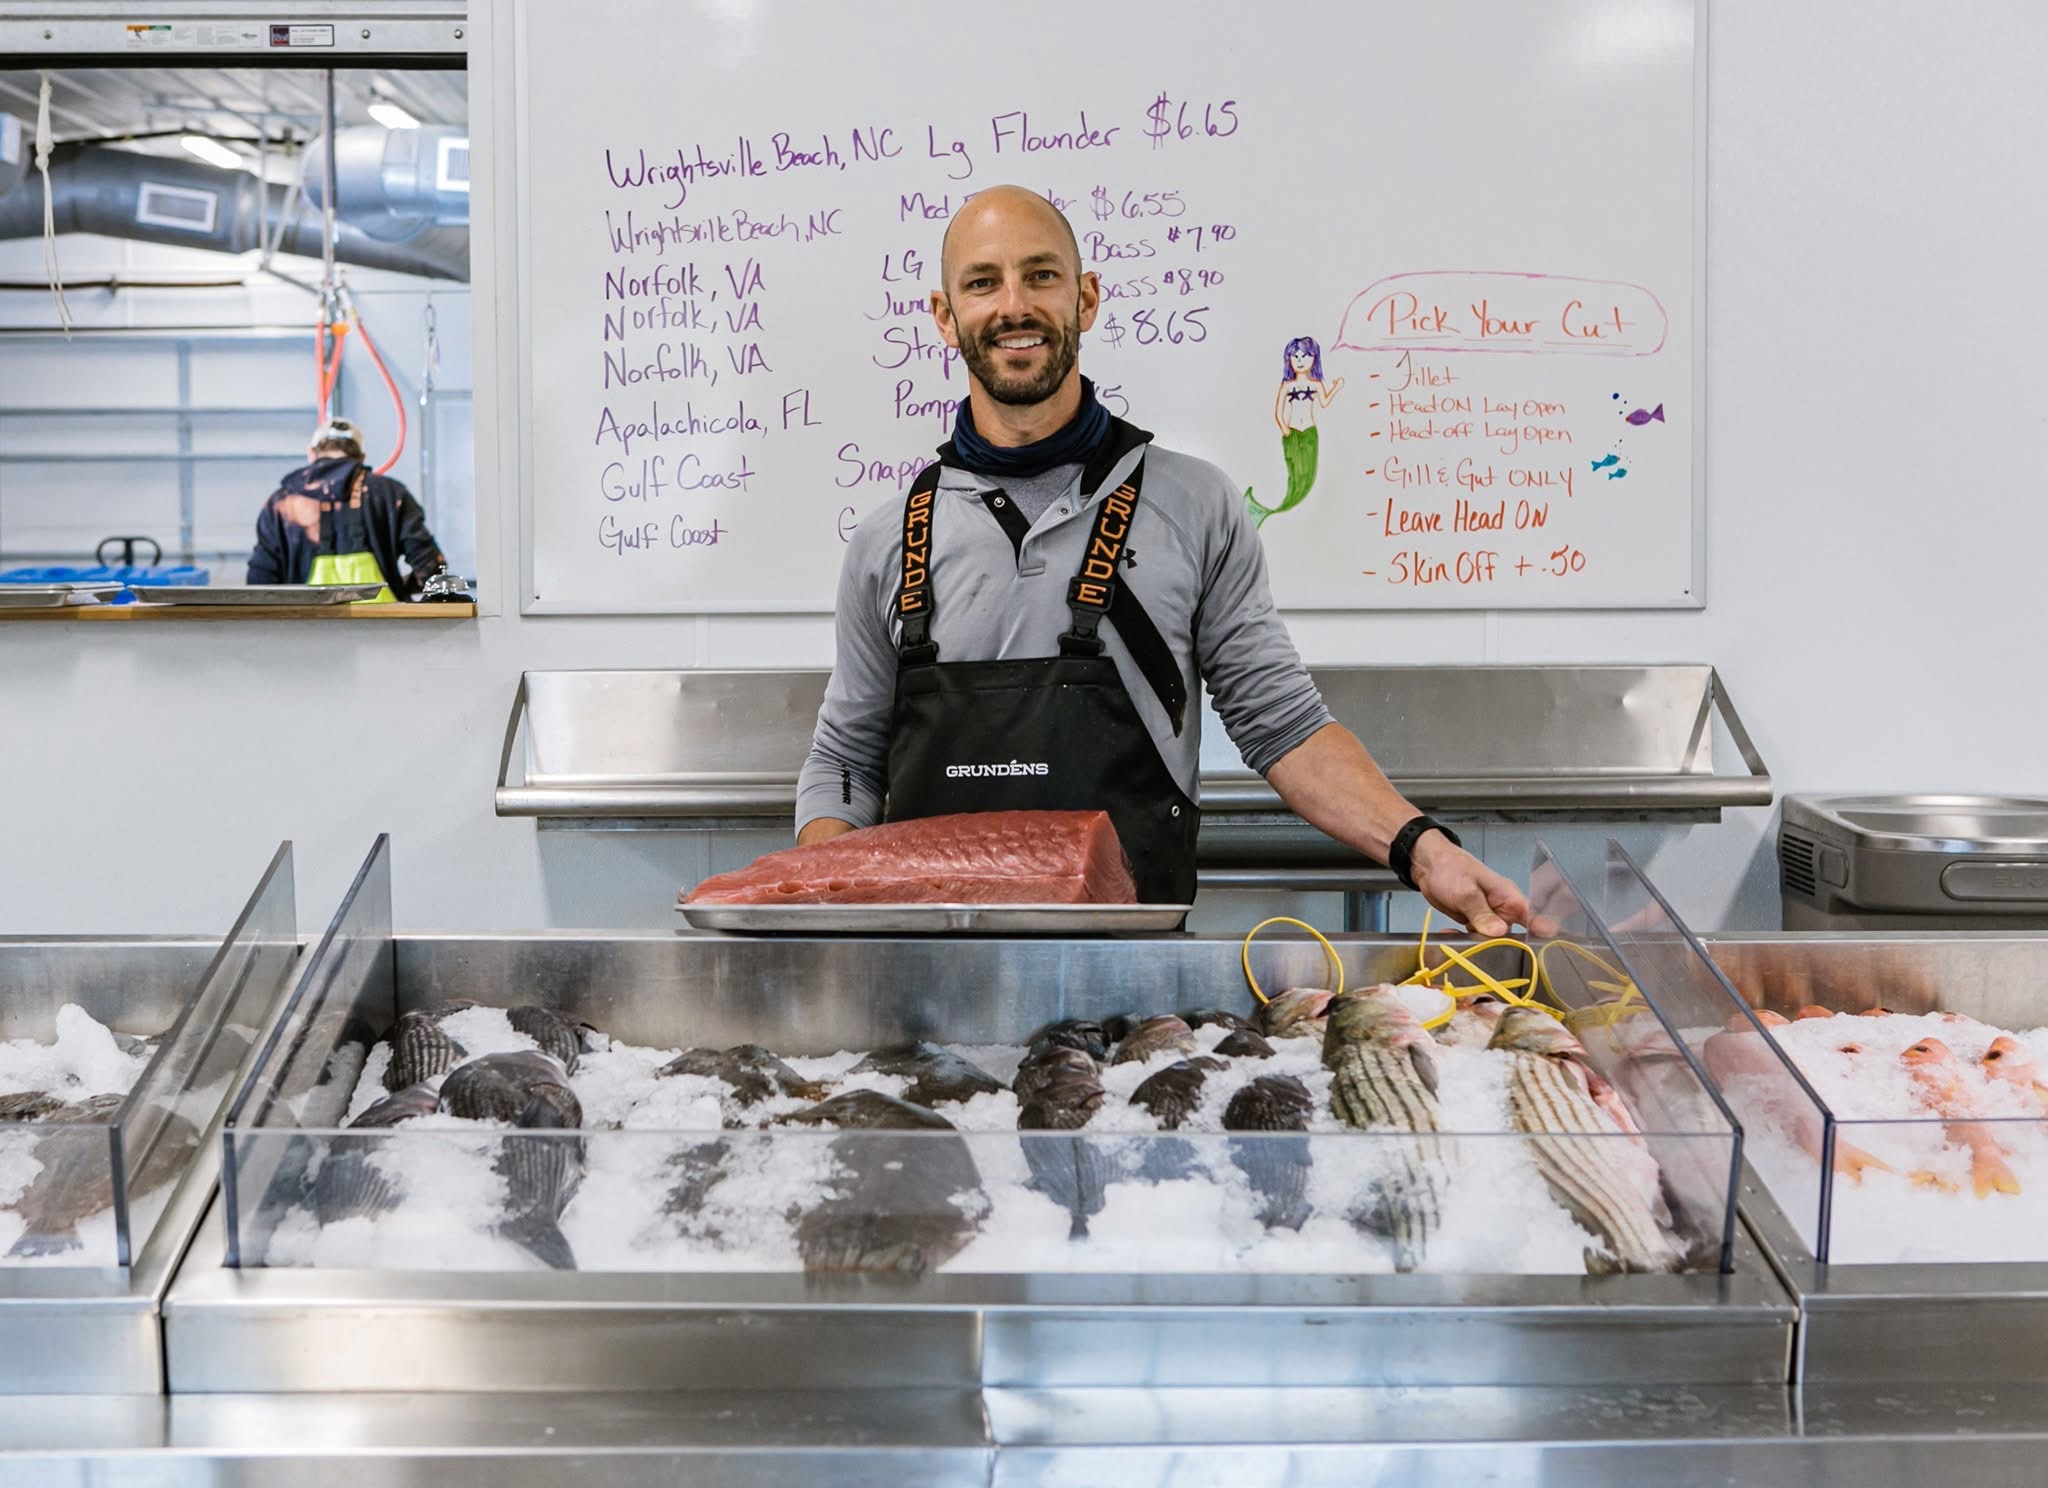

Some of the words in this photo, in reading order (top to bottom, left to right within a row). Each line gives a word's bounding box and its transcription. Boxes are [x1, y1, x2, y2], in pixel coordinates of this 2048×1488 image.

[606, 136, 767, 209] Wrightsville
[772, 133, 846, 171] Beach,
[853, 127, 902, 161] NC
[929, 125, 973, 180] Lg
[992, 111, 1120, 152] Flounder
[1143, 91, 1238, 150] $6.65
[606, 210, 733, 255] Wrightsville
[900, 192, 950, 222] Med
[1089, 185, 1186, 221] $6.55
[881, 250, 924, 282] LG
[1083, 231, 1156, 262] Bass
[605, 263, 717, 302] Norfolk,
[725, 257, 767, 300] VA
[604, 297, 717, 341] Norfolk,
[725, 302, 765, 334] VA
[1100, 307, 1210, 350] $8.65
[1367, 291, 1461, 335] Pick
[1472, 299, 1541, 338] Your
[1562, 300, 1636, 338] Cut
[604, 343, 718, 388] Norfolk,
[728, 343, 773, 375] VA
[595, 400, 768, 455] Apalachicola,
[782, 389, 822, 430] FL
[894, 379, 960, 434] Pomp
[1484, 395, 1518, 420] Lay
[1523, 400, 1566, 417] Open
[1485, 422, 1518, 455] Lay
[1523, 426, 1573, 444] Open
[601, 455, 669, 501] Gulf
[677, 454, 755, 492] Coast
[1384, 456, 1431, 489] Gill
[1456, 457, 1498, 492] Gut
[1508, 467, 1574, 498] ONLY
[598, 515, 659, 555] Gulf
[670, 514, 728, 549] Coast
[1385, 498, 1444, 536] Leave
[1454, 499, 1505, 533] Head
[1514, 500, 1549, 529] ON
[1387, 551, 1451, 586] Skin
[1456, 550, 1499, 584] Off
